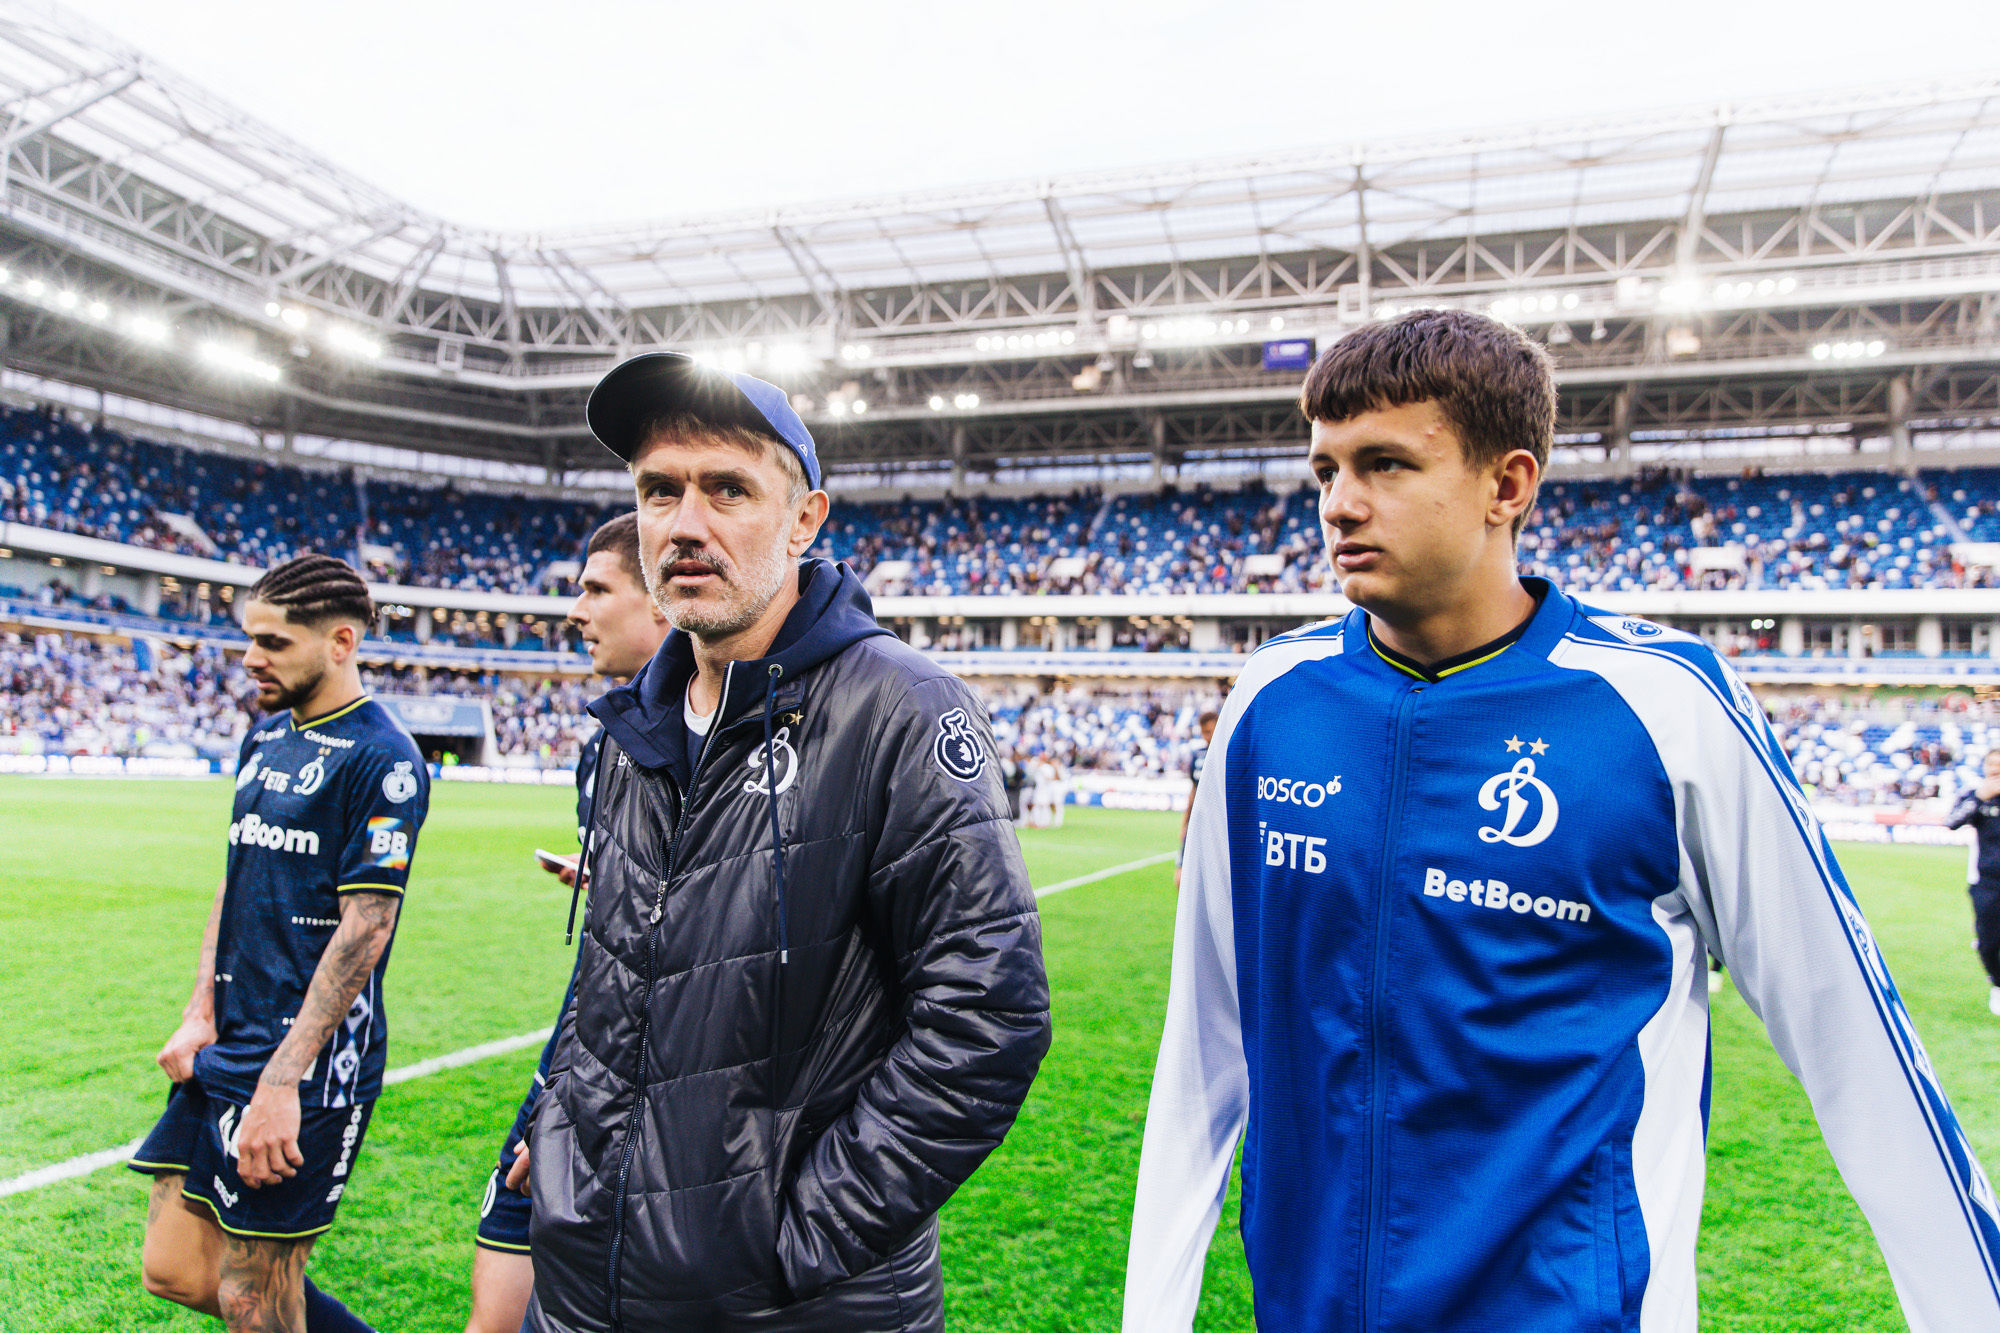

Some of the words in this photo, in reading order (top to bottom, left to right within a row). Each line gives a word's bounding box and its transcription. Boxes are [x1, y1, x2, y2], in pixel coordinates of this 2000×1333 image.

[1257, 775, 1326, 808] BOSCO
[228, 813, 320, 855] eBoom
[370, 829, 409, 856] BB
[1265, 830, 1328, 874] ВТБ
[1423, 867, 1592, 923] BetBoom
[332, 1103, 363, 1177] BetBo
